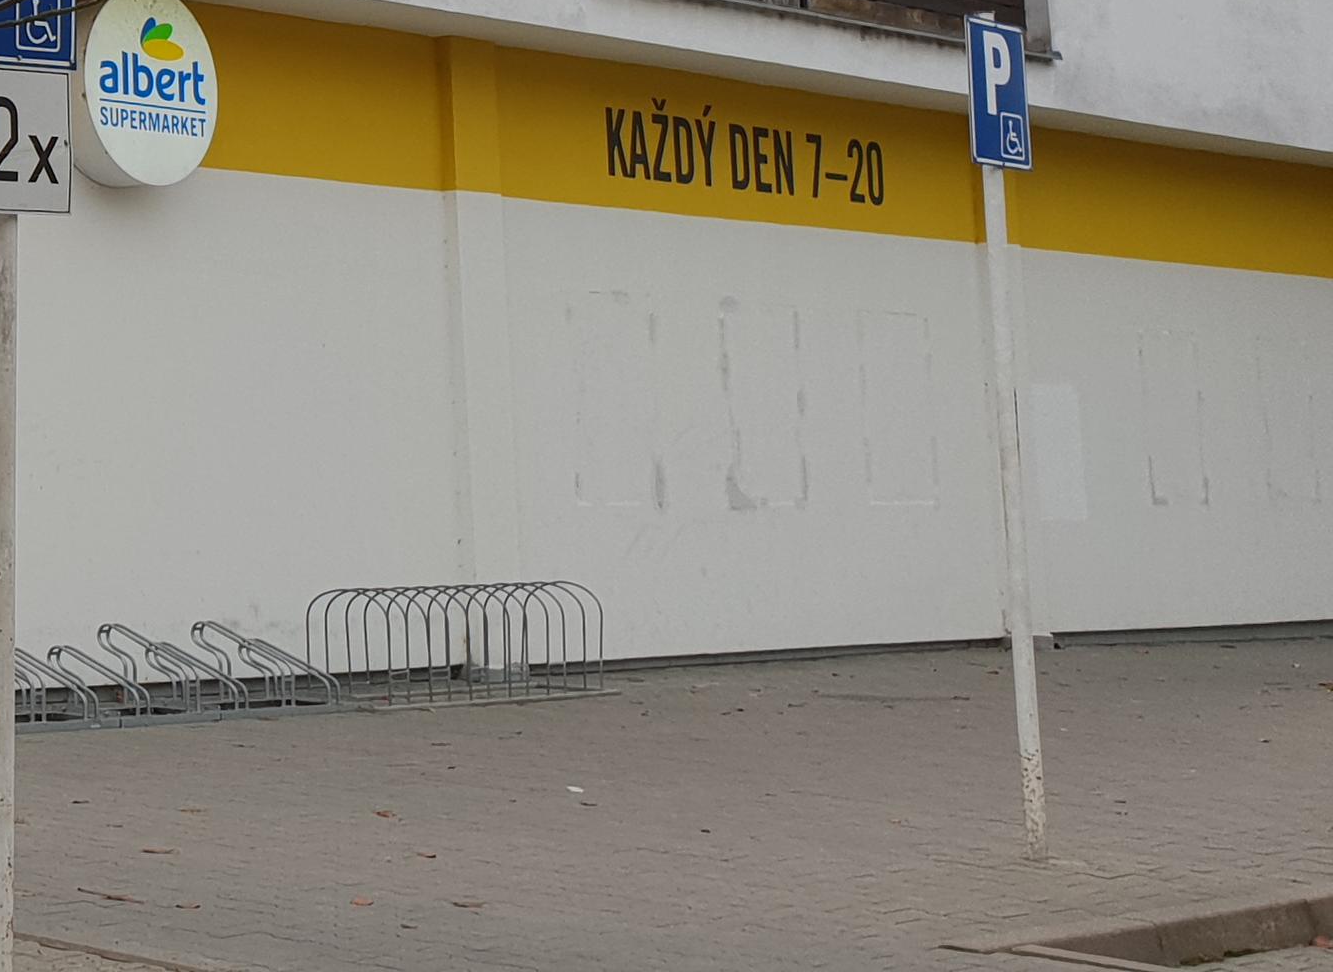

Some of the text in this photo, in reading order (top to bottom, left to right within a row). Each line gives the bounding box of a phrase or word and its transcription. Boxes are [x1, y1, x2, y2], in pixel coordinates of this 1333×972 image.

[99, 51, 206, 105] albert
[983, 30, 1011, 115] P
[100, 107, 206, 138] SUPERMARKET
[605, 98, 716, 187] KAŽDÝ
[729, 123, 794, 196] DEN
